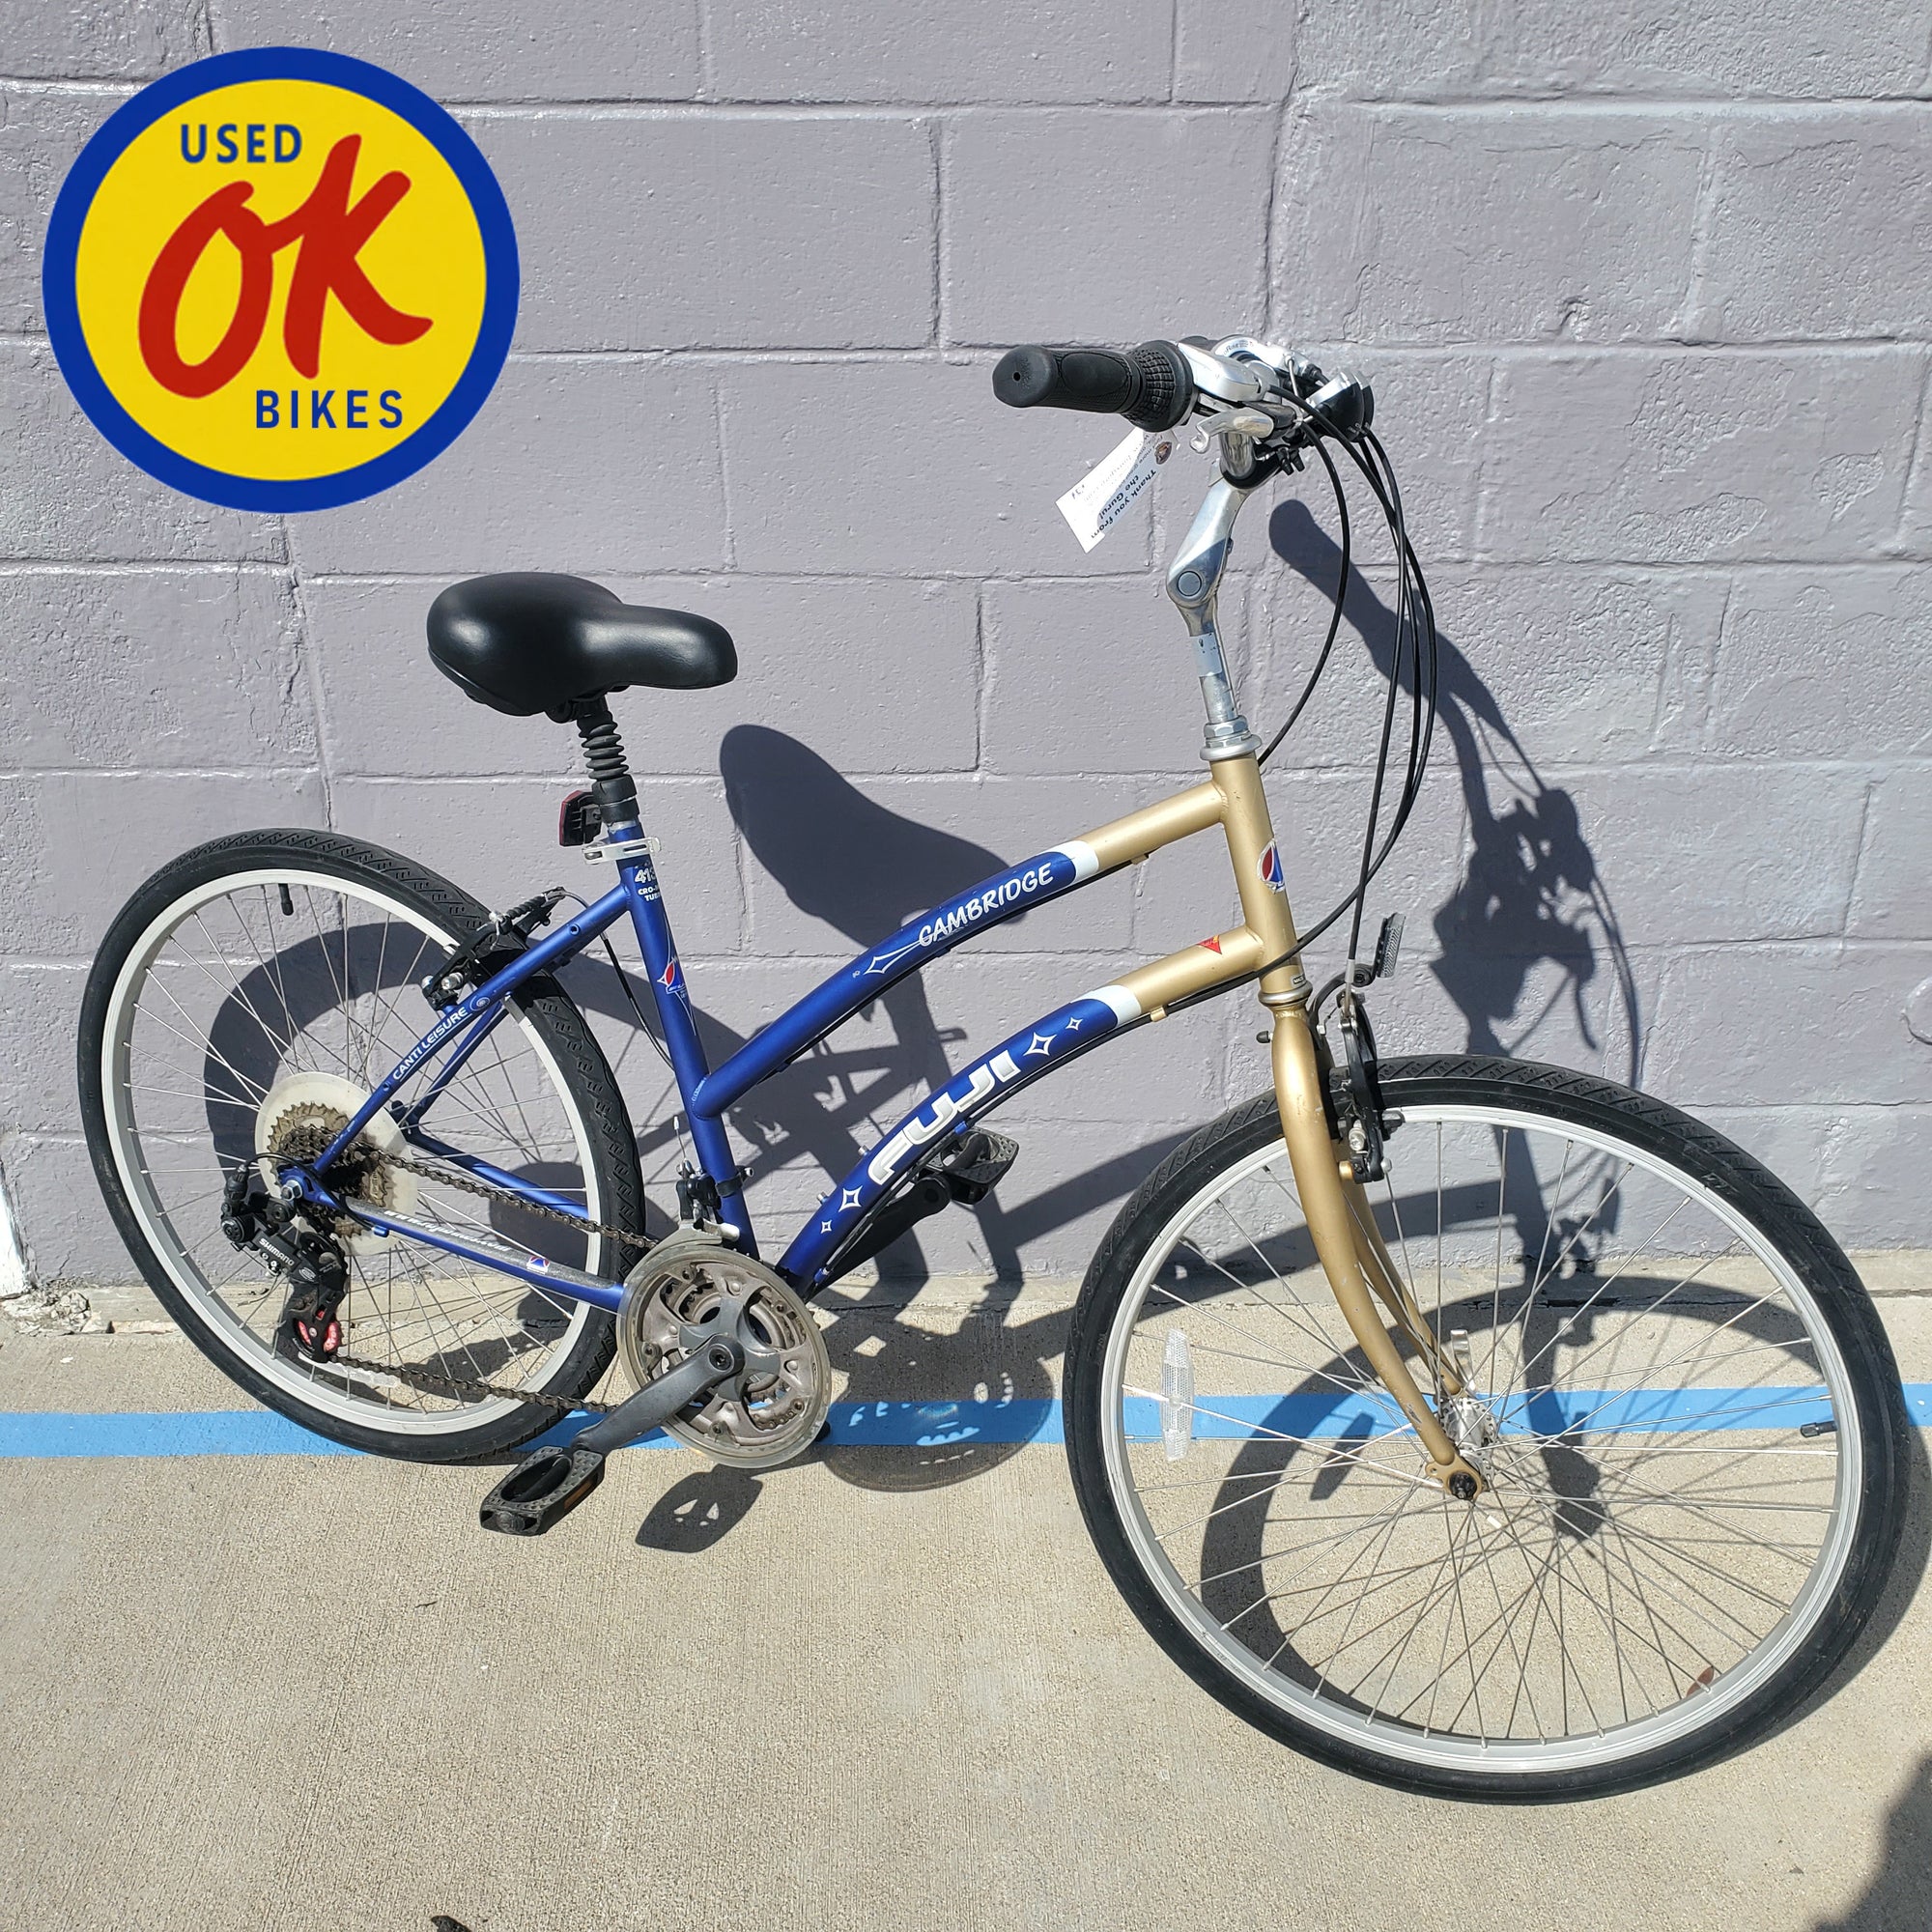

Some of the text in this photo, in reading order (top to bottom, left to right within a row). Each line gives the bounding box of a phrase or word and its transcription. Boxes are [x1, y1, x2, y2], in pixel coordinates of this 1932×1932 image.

[1131, 469, 1157, 498] Thank
[1114, 496, 1130, 516] you
[1091, 515, 1115, 539] from
[918, 862, 1055, 947] CAMBRIDGE
[392, 1007, 469, 1080] CANTI LEISURE
[258, 1236, 295, 1266] SHIMANO
